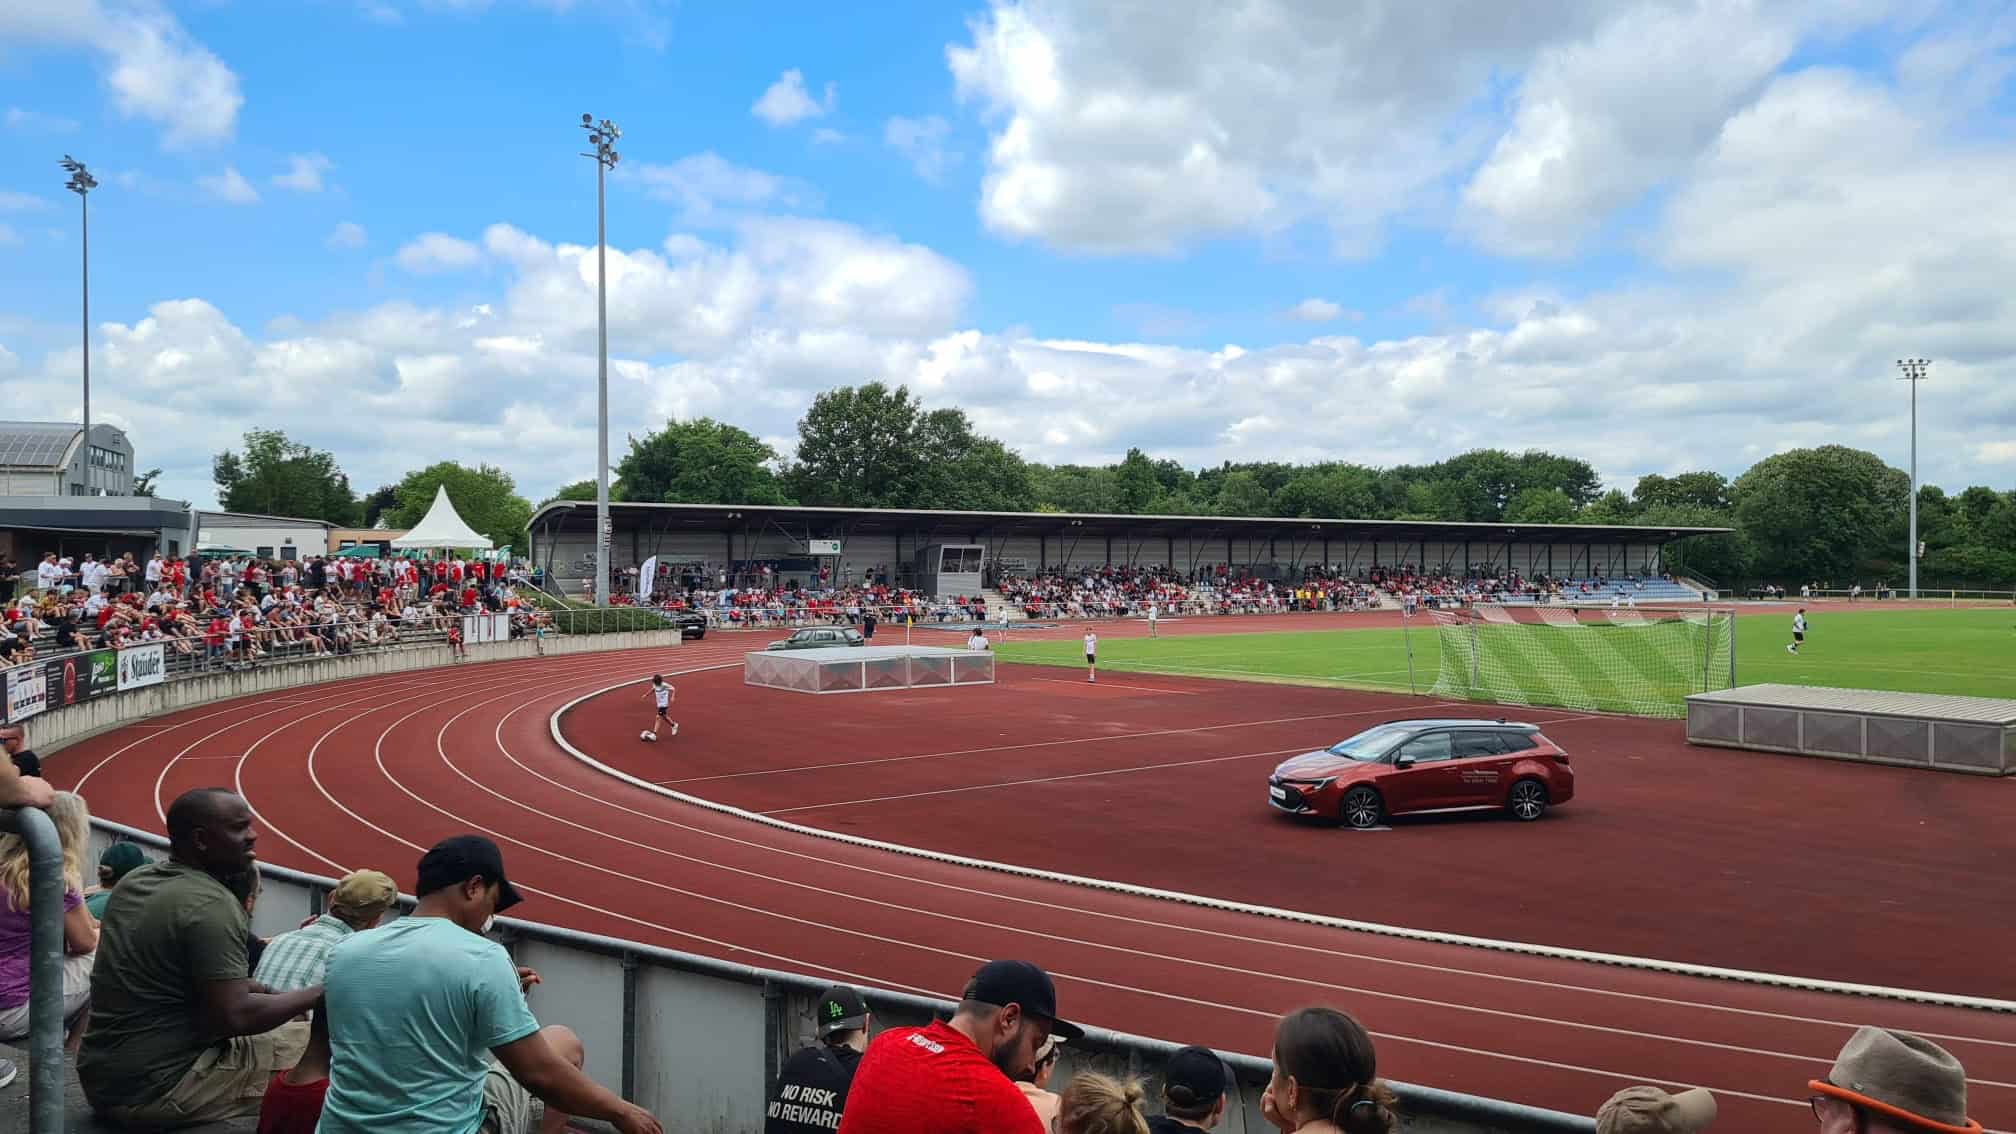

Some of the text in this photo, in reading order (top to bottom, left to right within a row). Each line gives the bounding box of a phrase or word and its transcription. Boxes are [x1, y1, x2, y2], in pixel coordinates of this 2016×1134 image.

[829, 1001, 844, 1017] LA
[780, 1084, 838, 1107] NO RISK
[767, 1101, 843, 1130] NO REWARD
